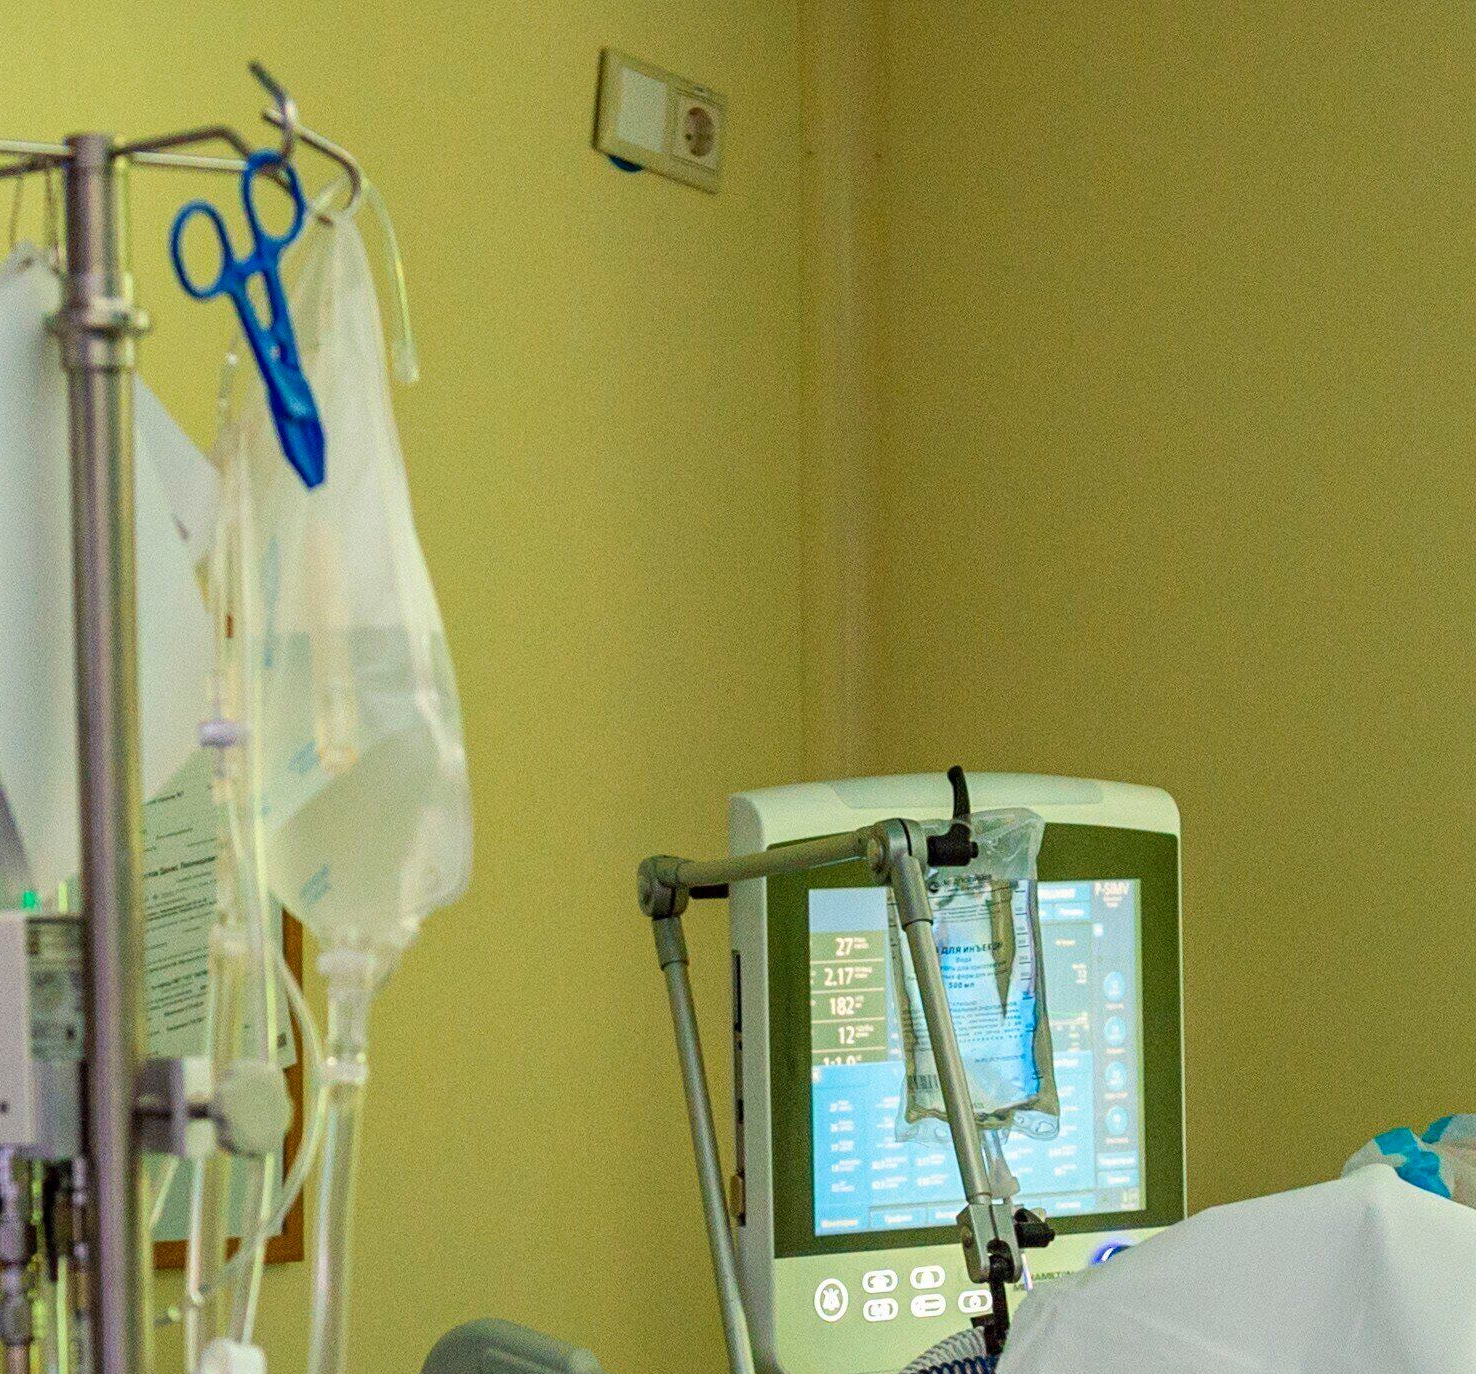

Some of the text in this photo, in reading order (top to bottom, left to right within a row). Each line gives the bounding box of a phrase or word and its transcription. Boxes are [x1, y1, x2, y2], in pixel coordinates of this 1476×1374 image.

[835, 937, 854, 956] 27
[941, 946, 961, 955] ДЛЯ
[824, 966, 855, 986] 2.17
[829, 996, 855, 1016] 182
[838, 1025, 855, 1044] 12
